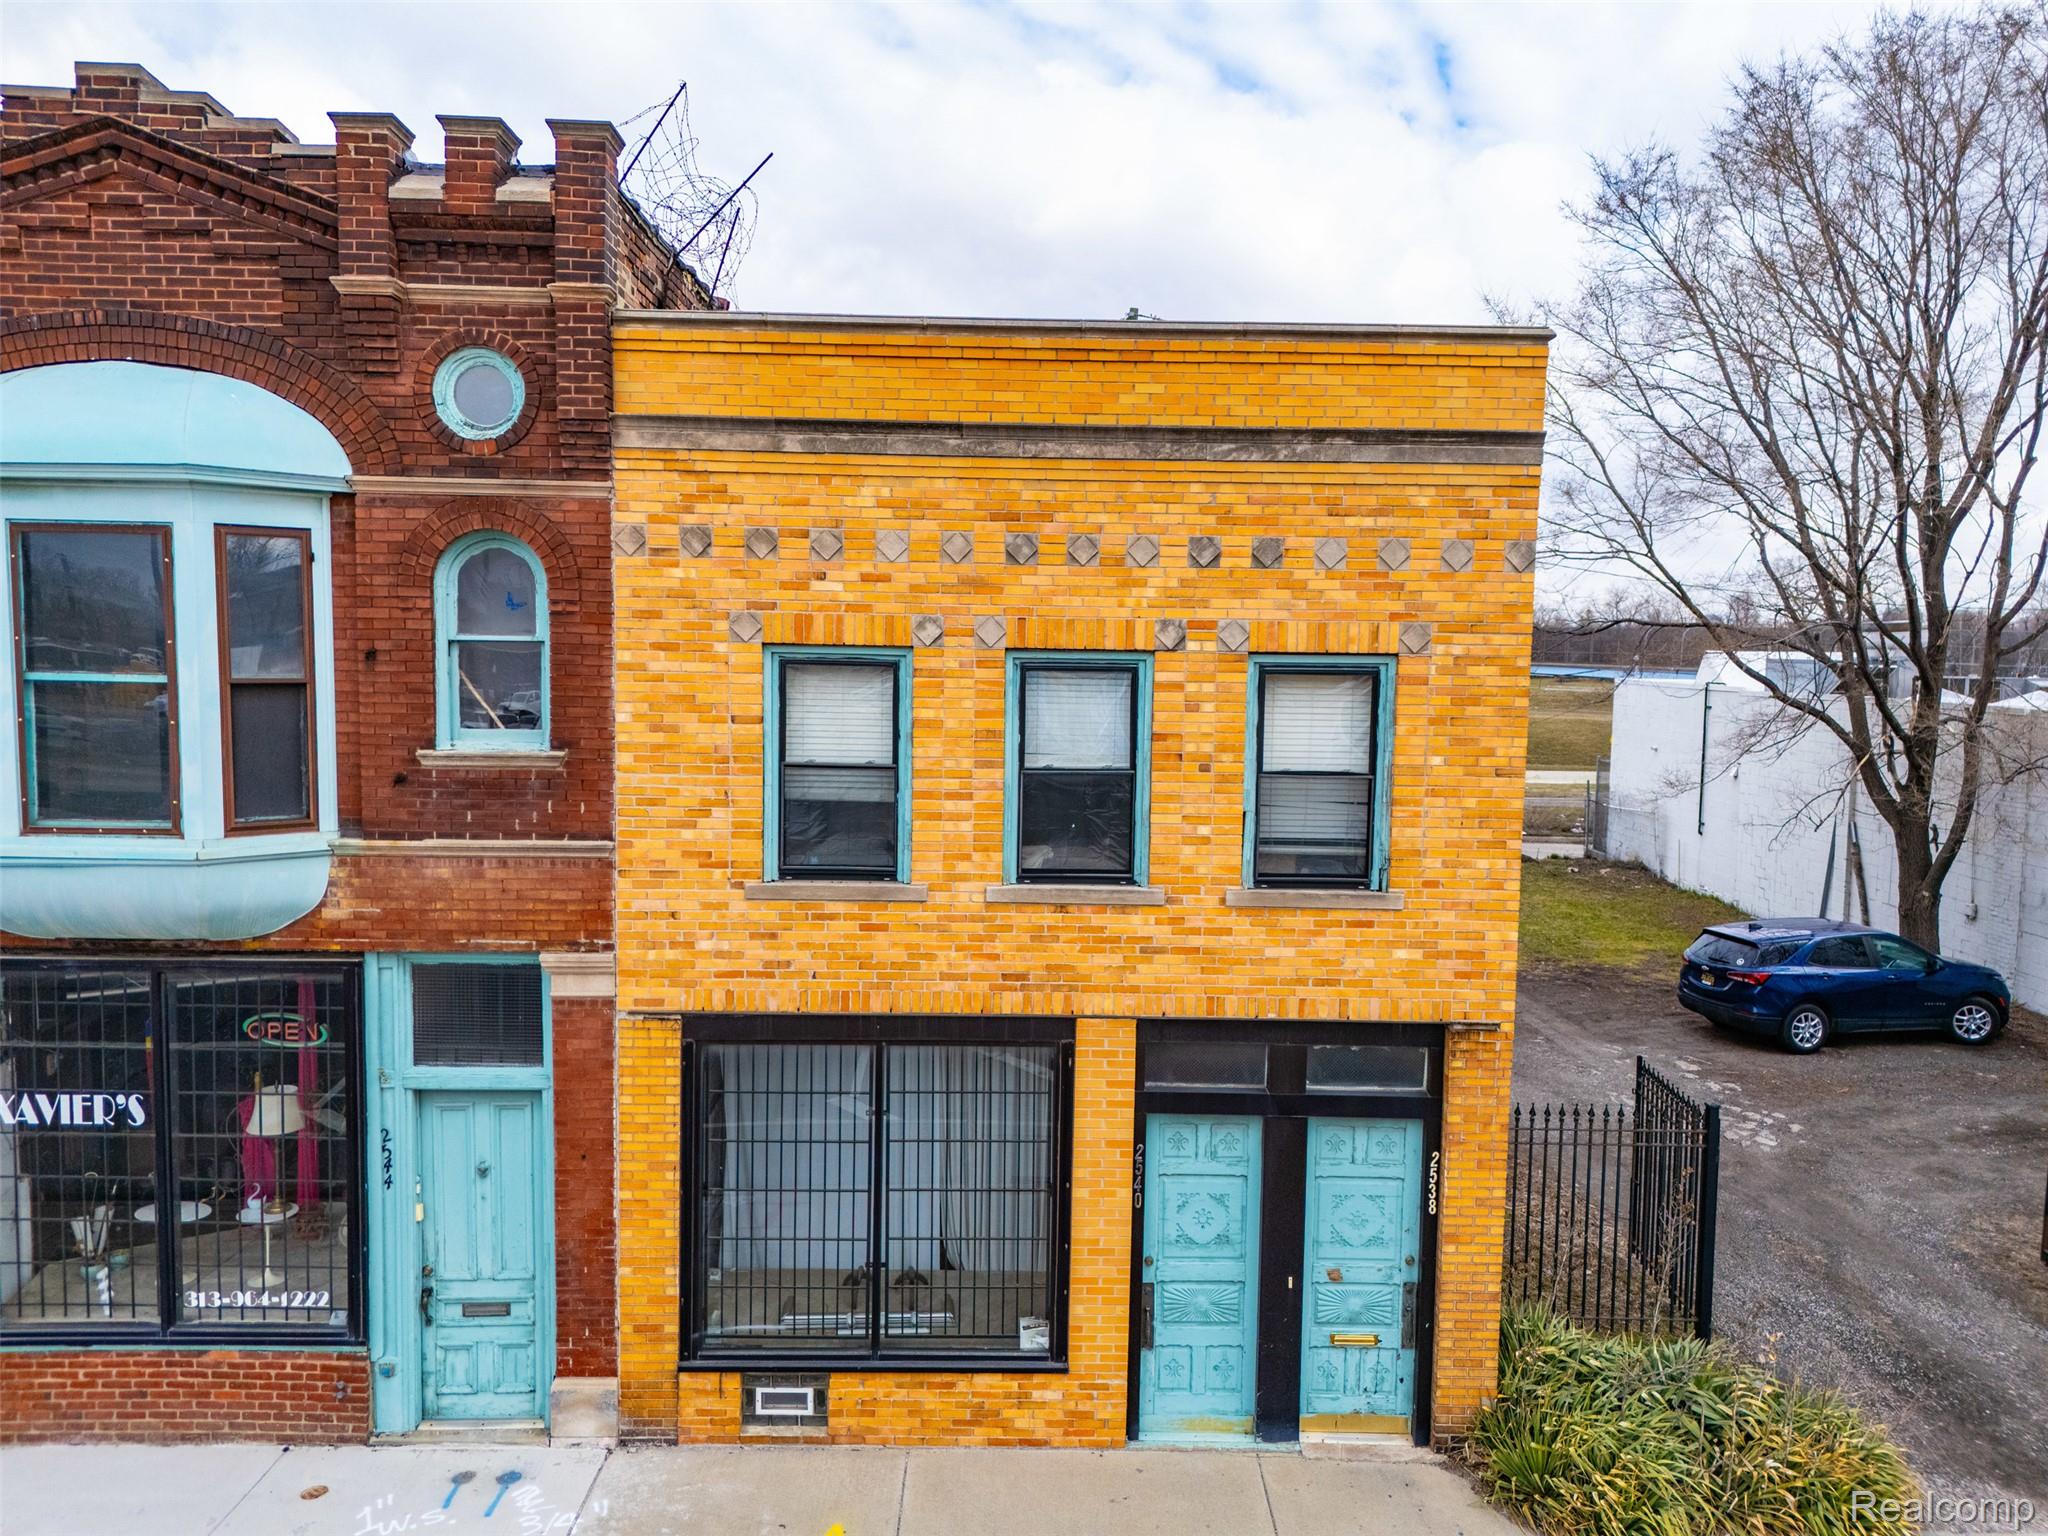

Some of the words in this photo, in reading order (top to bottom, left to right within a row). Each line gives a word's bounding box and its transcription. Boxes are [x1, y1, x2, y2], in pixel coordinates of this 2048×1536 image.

[247, 1021, 320, 1042] OPEN
[0, 1093, 146, 1126] XAVIER'S
[380, 1128, 394, 1190] 2544
[1133, 1144, 1145, 1208] 2540
[1427, 1151, 1440, 1215] 2538
[184, 1290, 330, 1308] 313-964-1222
